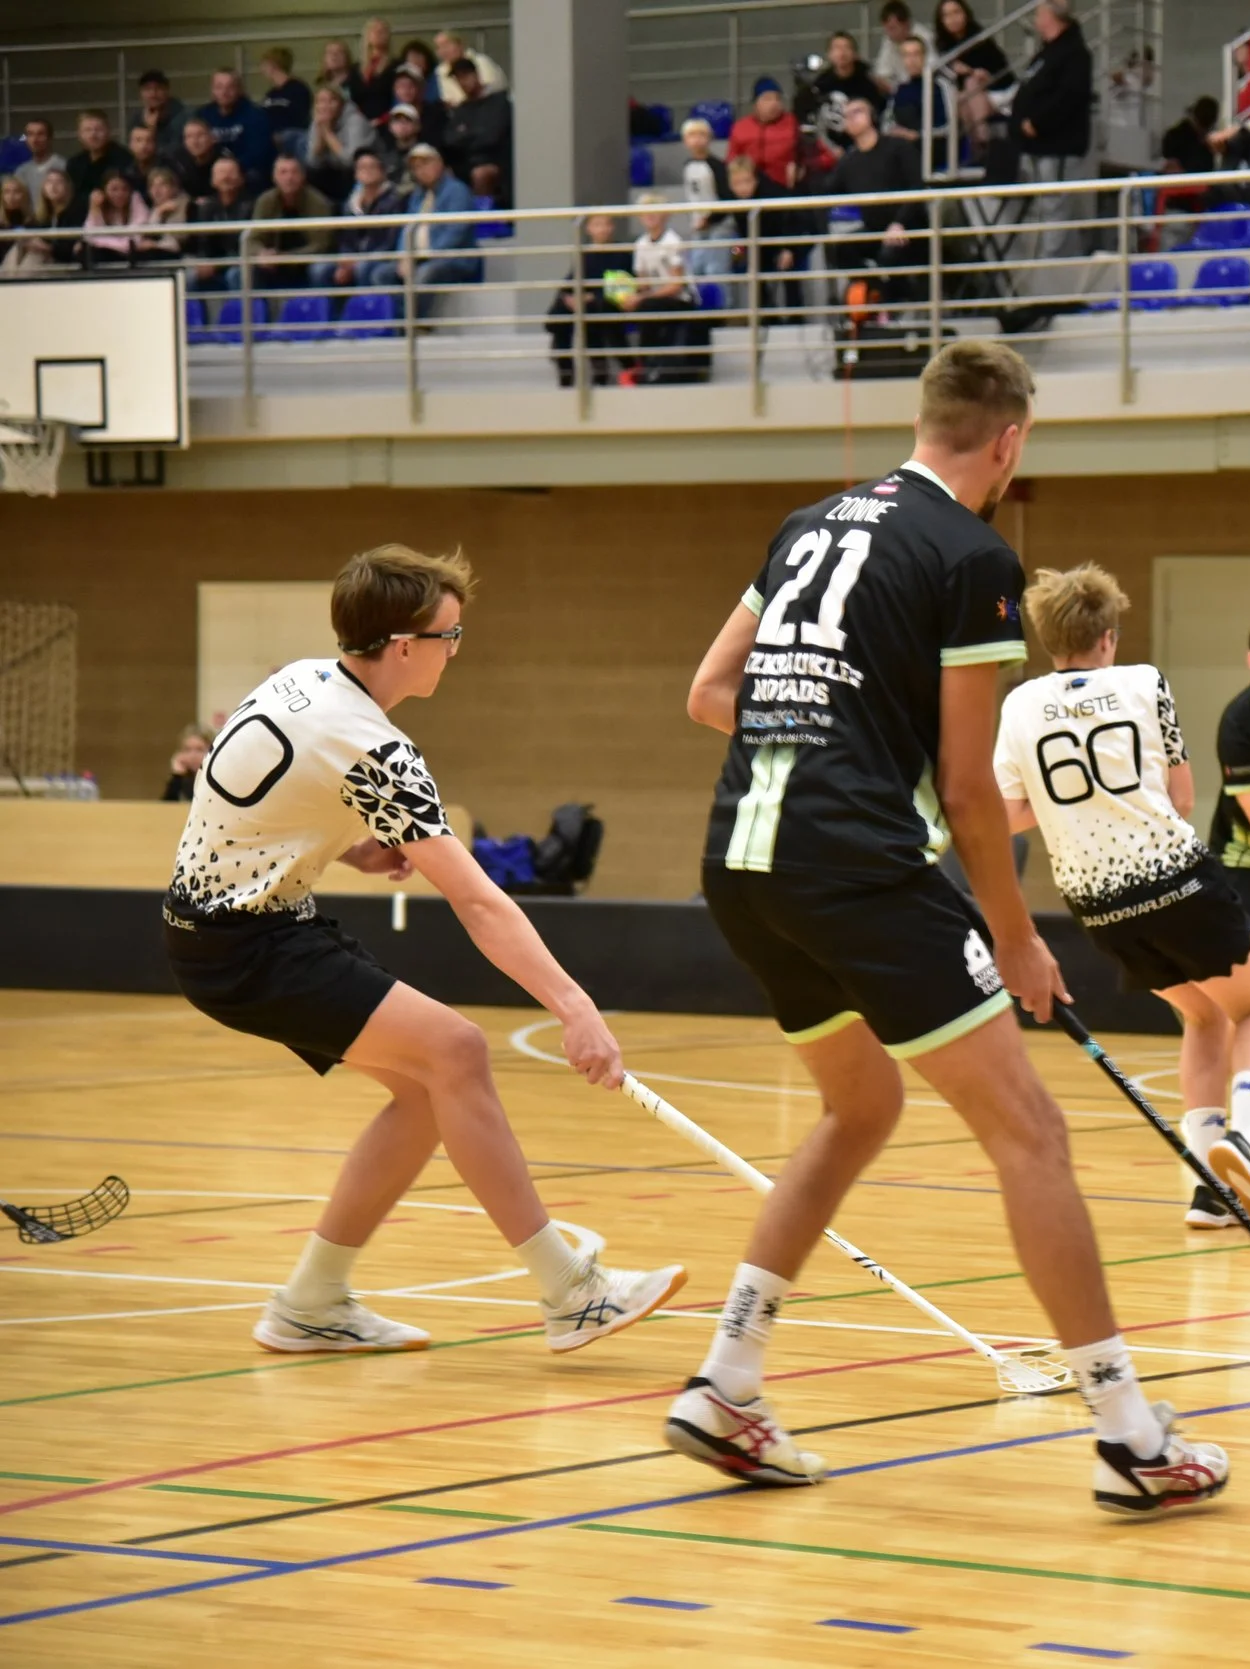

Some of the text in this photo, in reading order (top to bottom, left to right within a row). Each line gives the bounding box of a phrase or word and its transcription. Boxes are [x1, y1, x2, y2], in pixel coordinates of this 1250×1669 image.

[755, 527, 872, 652] 21
[1043, 692, 1120, 723] SUVISTE
[1036, 720, 1142, 806] 60
